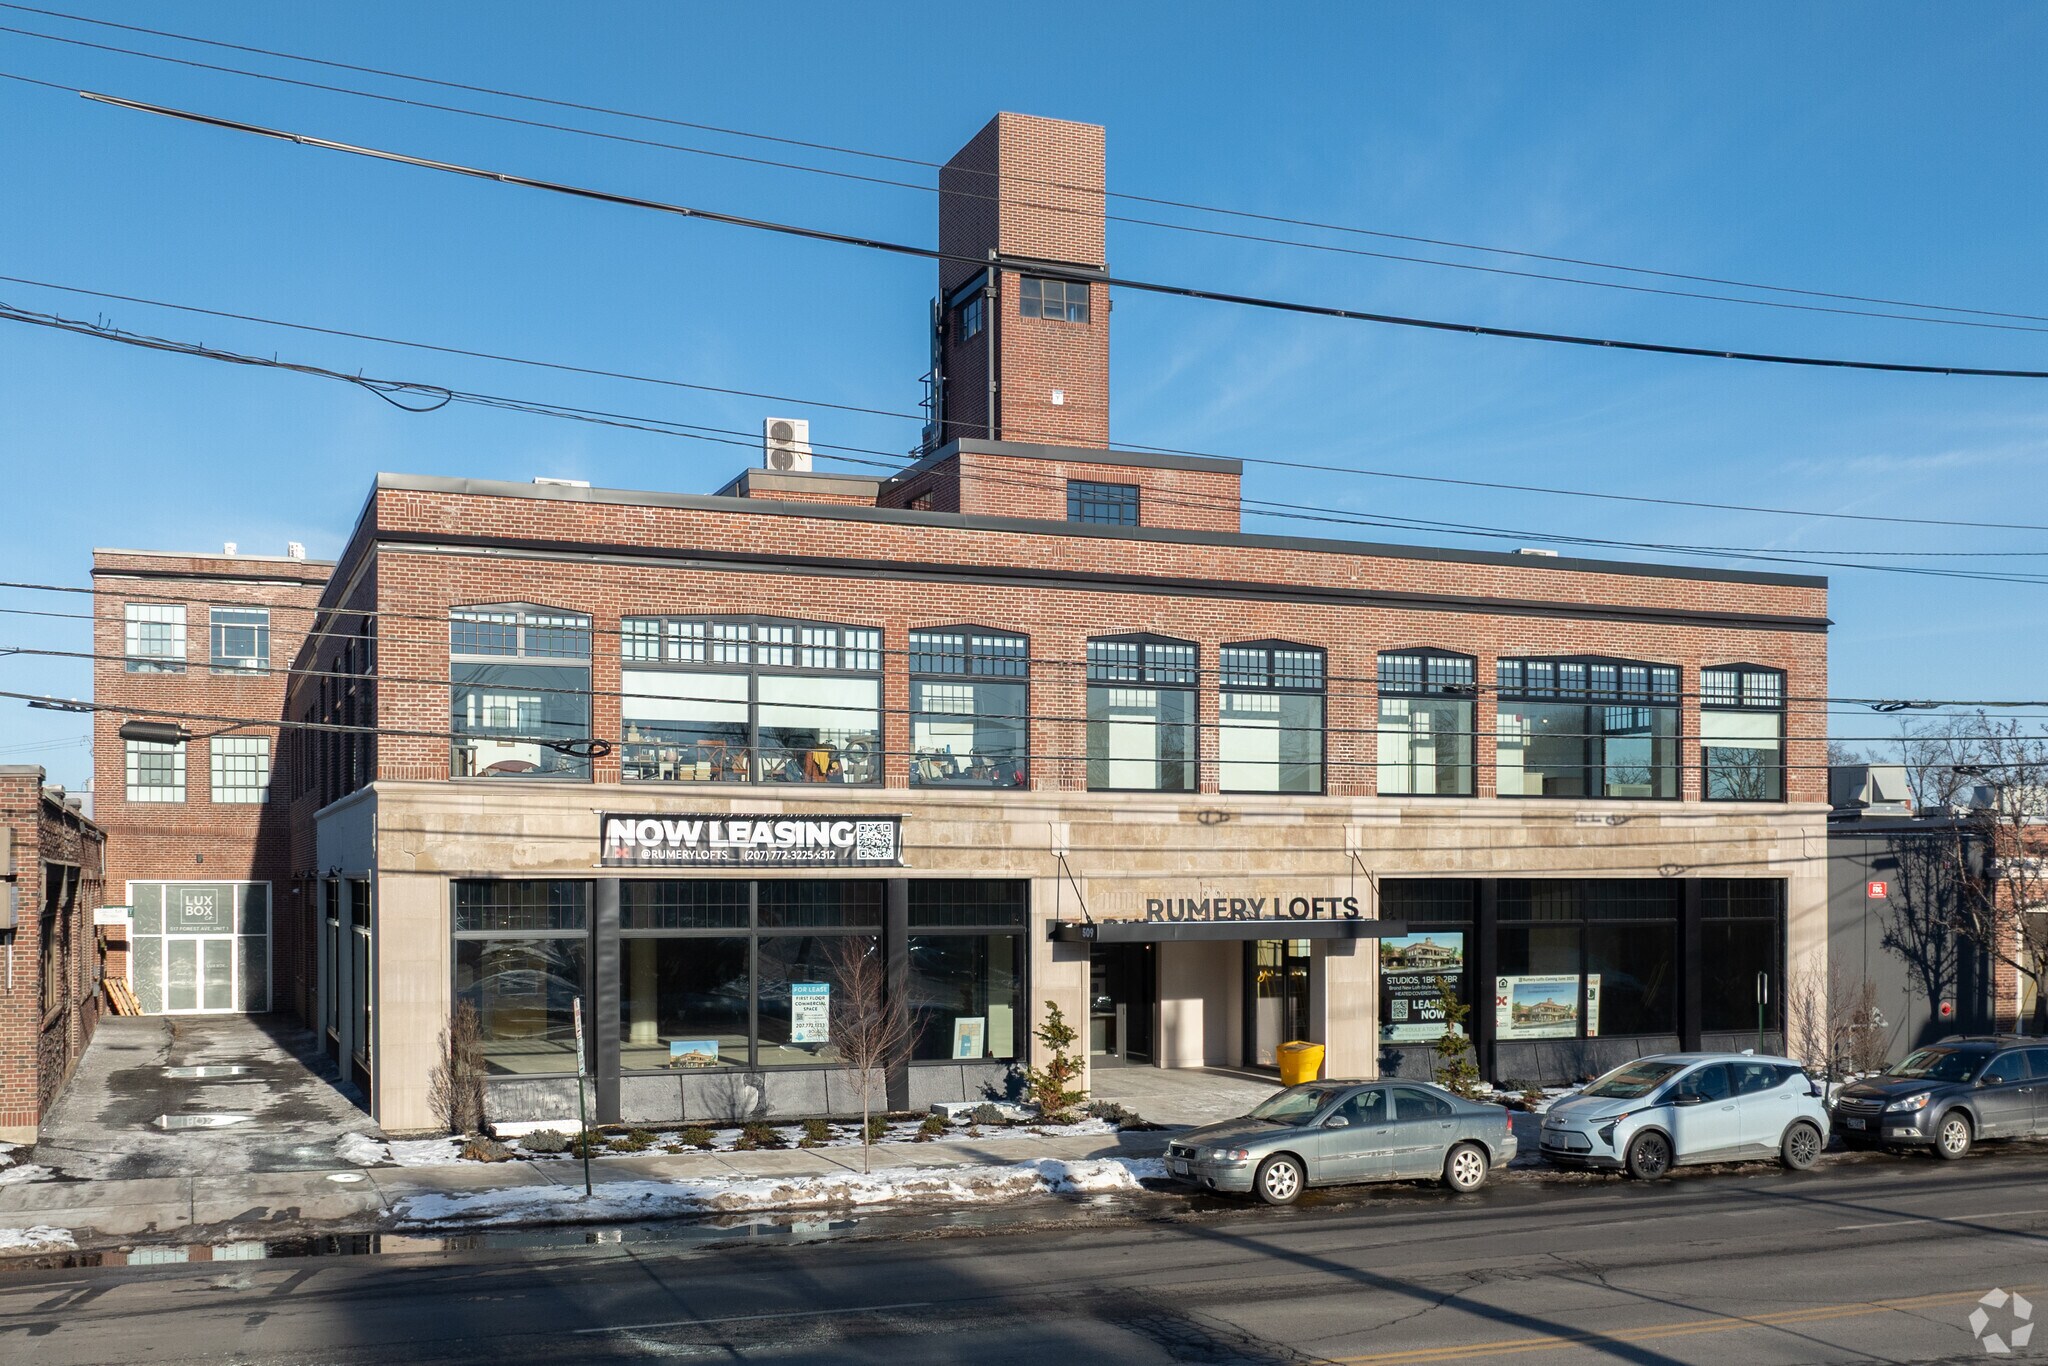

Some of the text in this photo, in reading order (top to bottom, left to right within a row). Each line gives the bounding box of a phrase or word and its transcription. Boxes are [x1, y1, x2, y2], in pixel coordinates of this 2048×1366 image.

[610, 819, 854, 848] NOW LEASING
[641, 849, 728, 860] @RUMERYLOFTS
[744, 849, 769, 861] (207)
[185, 896, 213, 906] LUX
[185, 906, 213, 916] BOX
[1146, 897, 1359, 921] RUMERY LOFTS
[1082, 927, 1094, 938] 509
[1386, 975, 1458, 985] STUDIOS, 1BR 2BR
[1420, 1010, 1446, 1020] NOW
